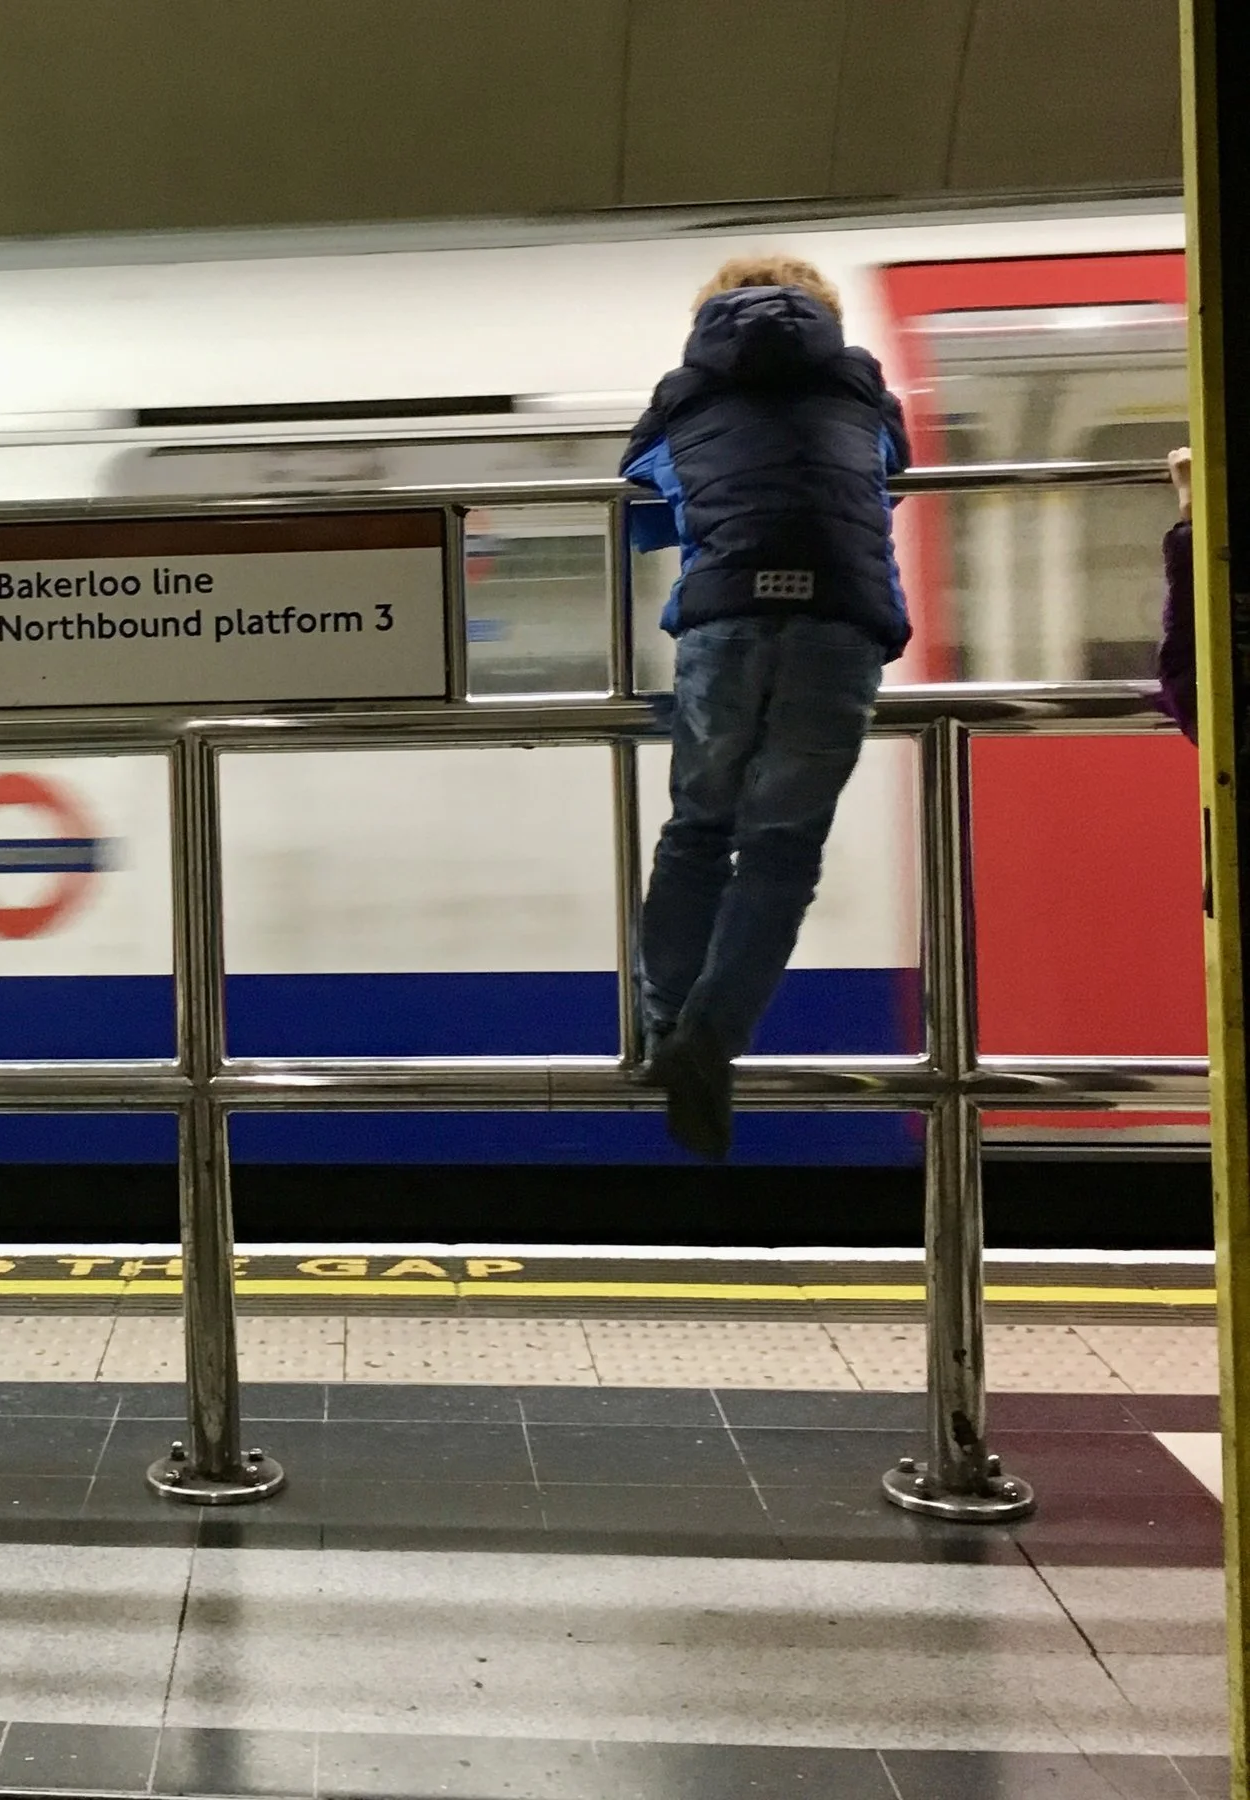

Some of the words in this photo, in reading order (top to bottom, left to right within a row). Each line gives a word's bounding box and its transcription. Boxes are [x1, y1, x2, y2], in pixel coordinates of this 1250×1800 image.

[152, 566, 214, 596] line
[214, 604, 363, 643] platform
[374, 603, 395, 632] 3
[296, 1258, 525, 1278] GAP
